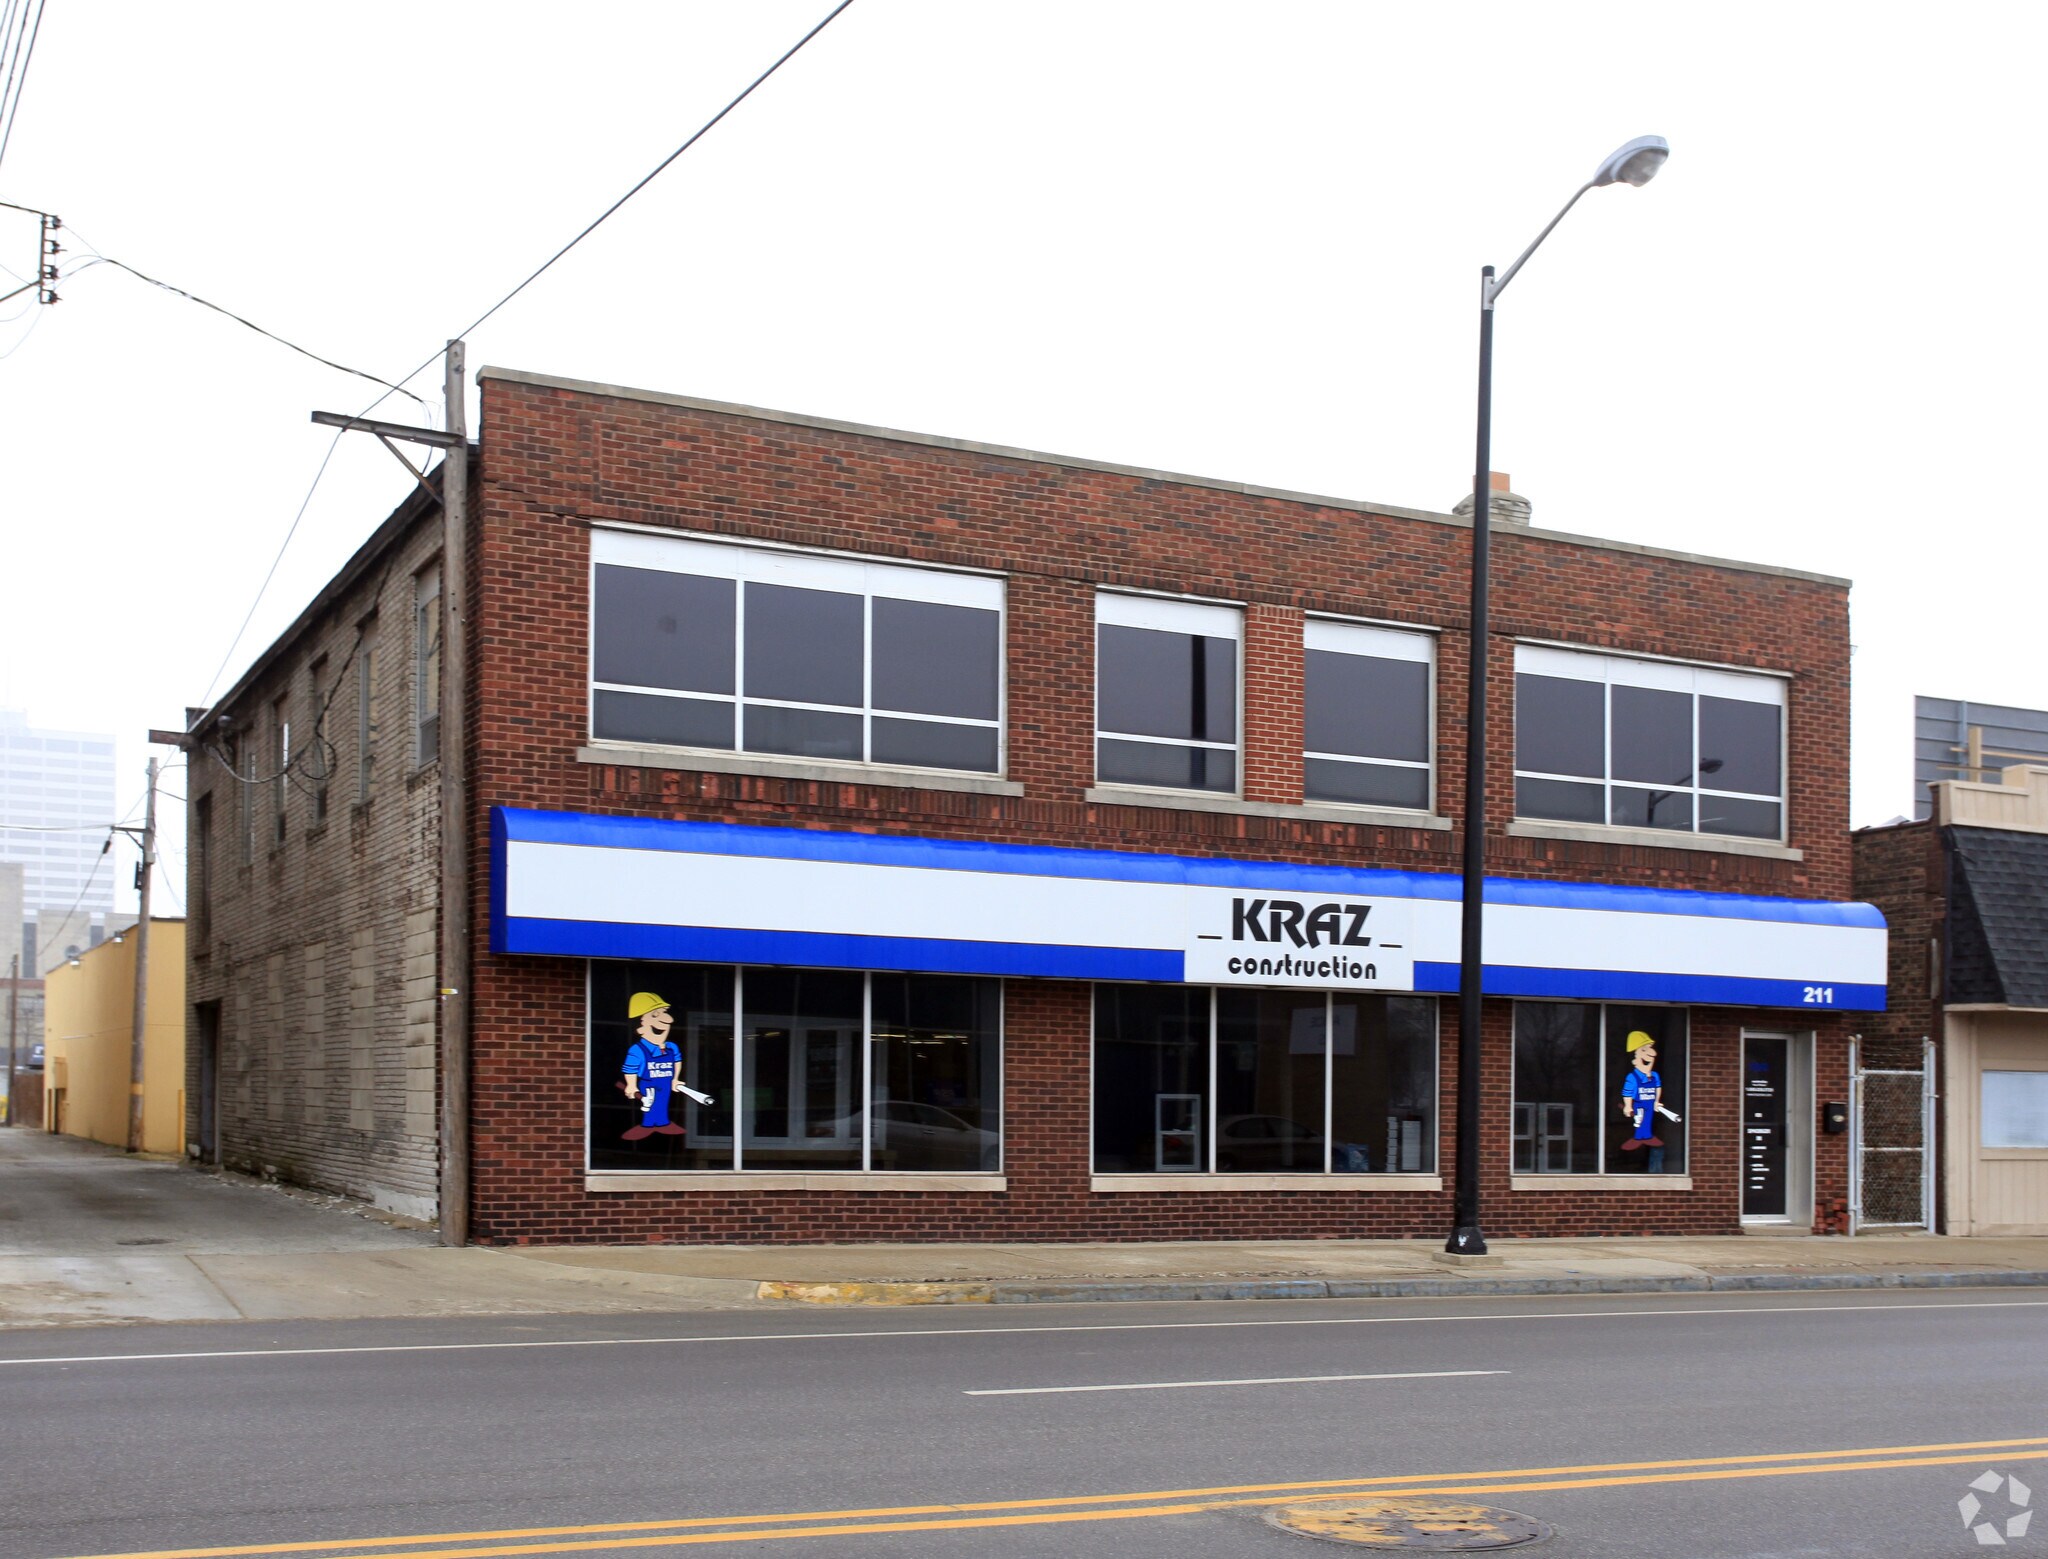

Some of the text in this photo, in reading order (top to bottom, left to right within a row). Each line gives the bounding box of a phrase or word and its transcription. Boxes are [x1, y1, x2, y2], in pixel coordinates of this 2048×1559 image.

[1232, 898, 1372, 949] KRAZ
[1228, 954, 1376, 979] construction
[1803, 986, 1833, 1003] 211
[647, 1061, 673, 1070] Kraz
